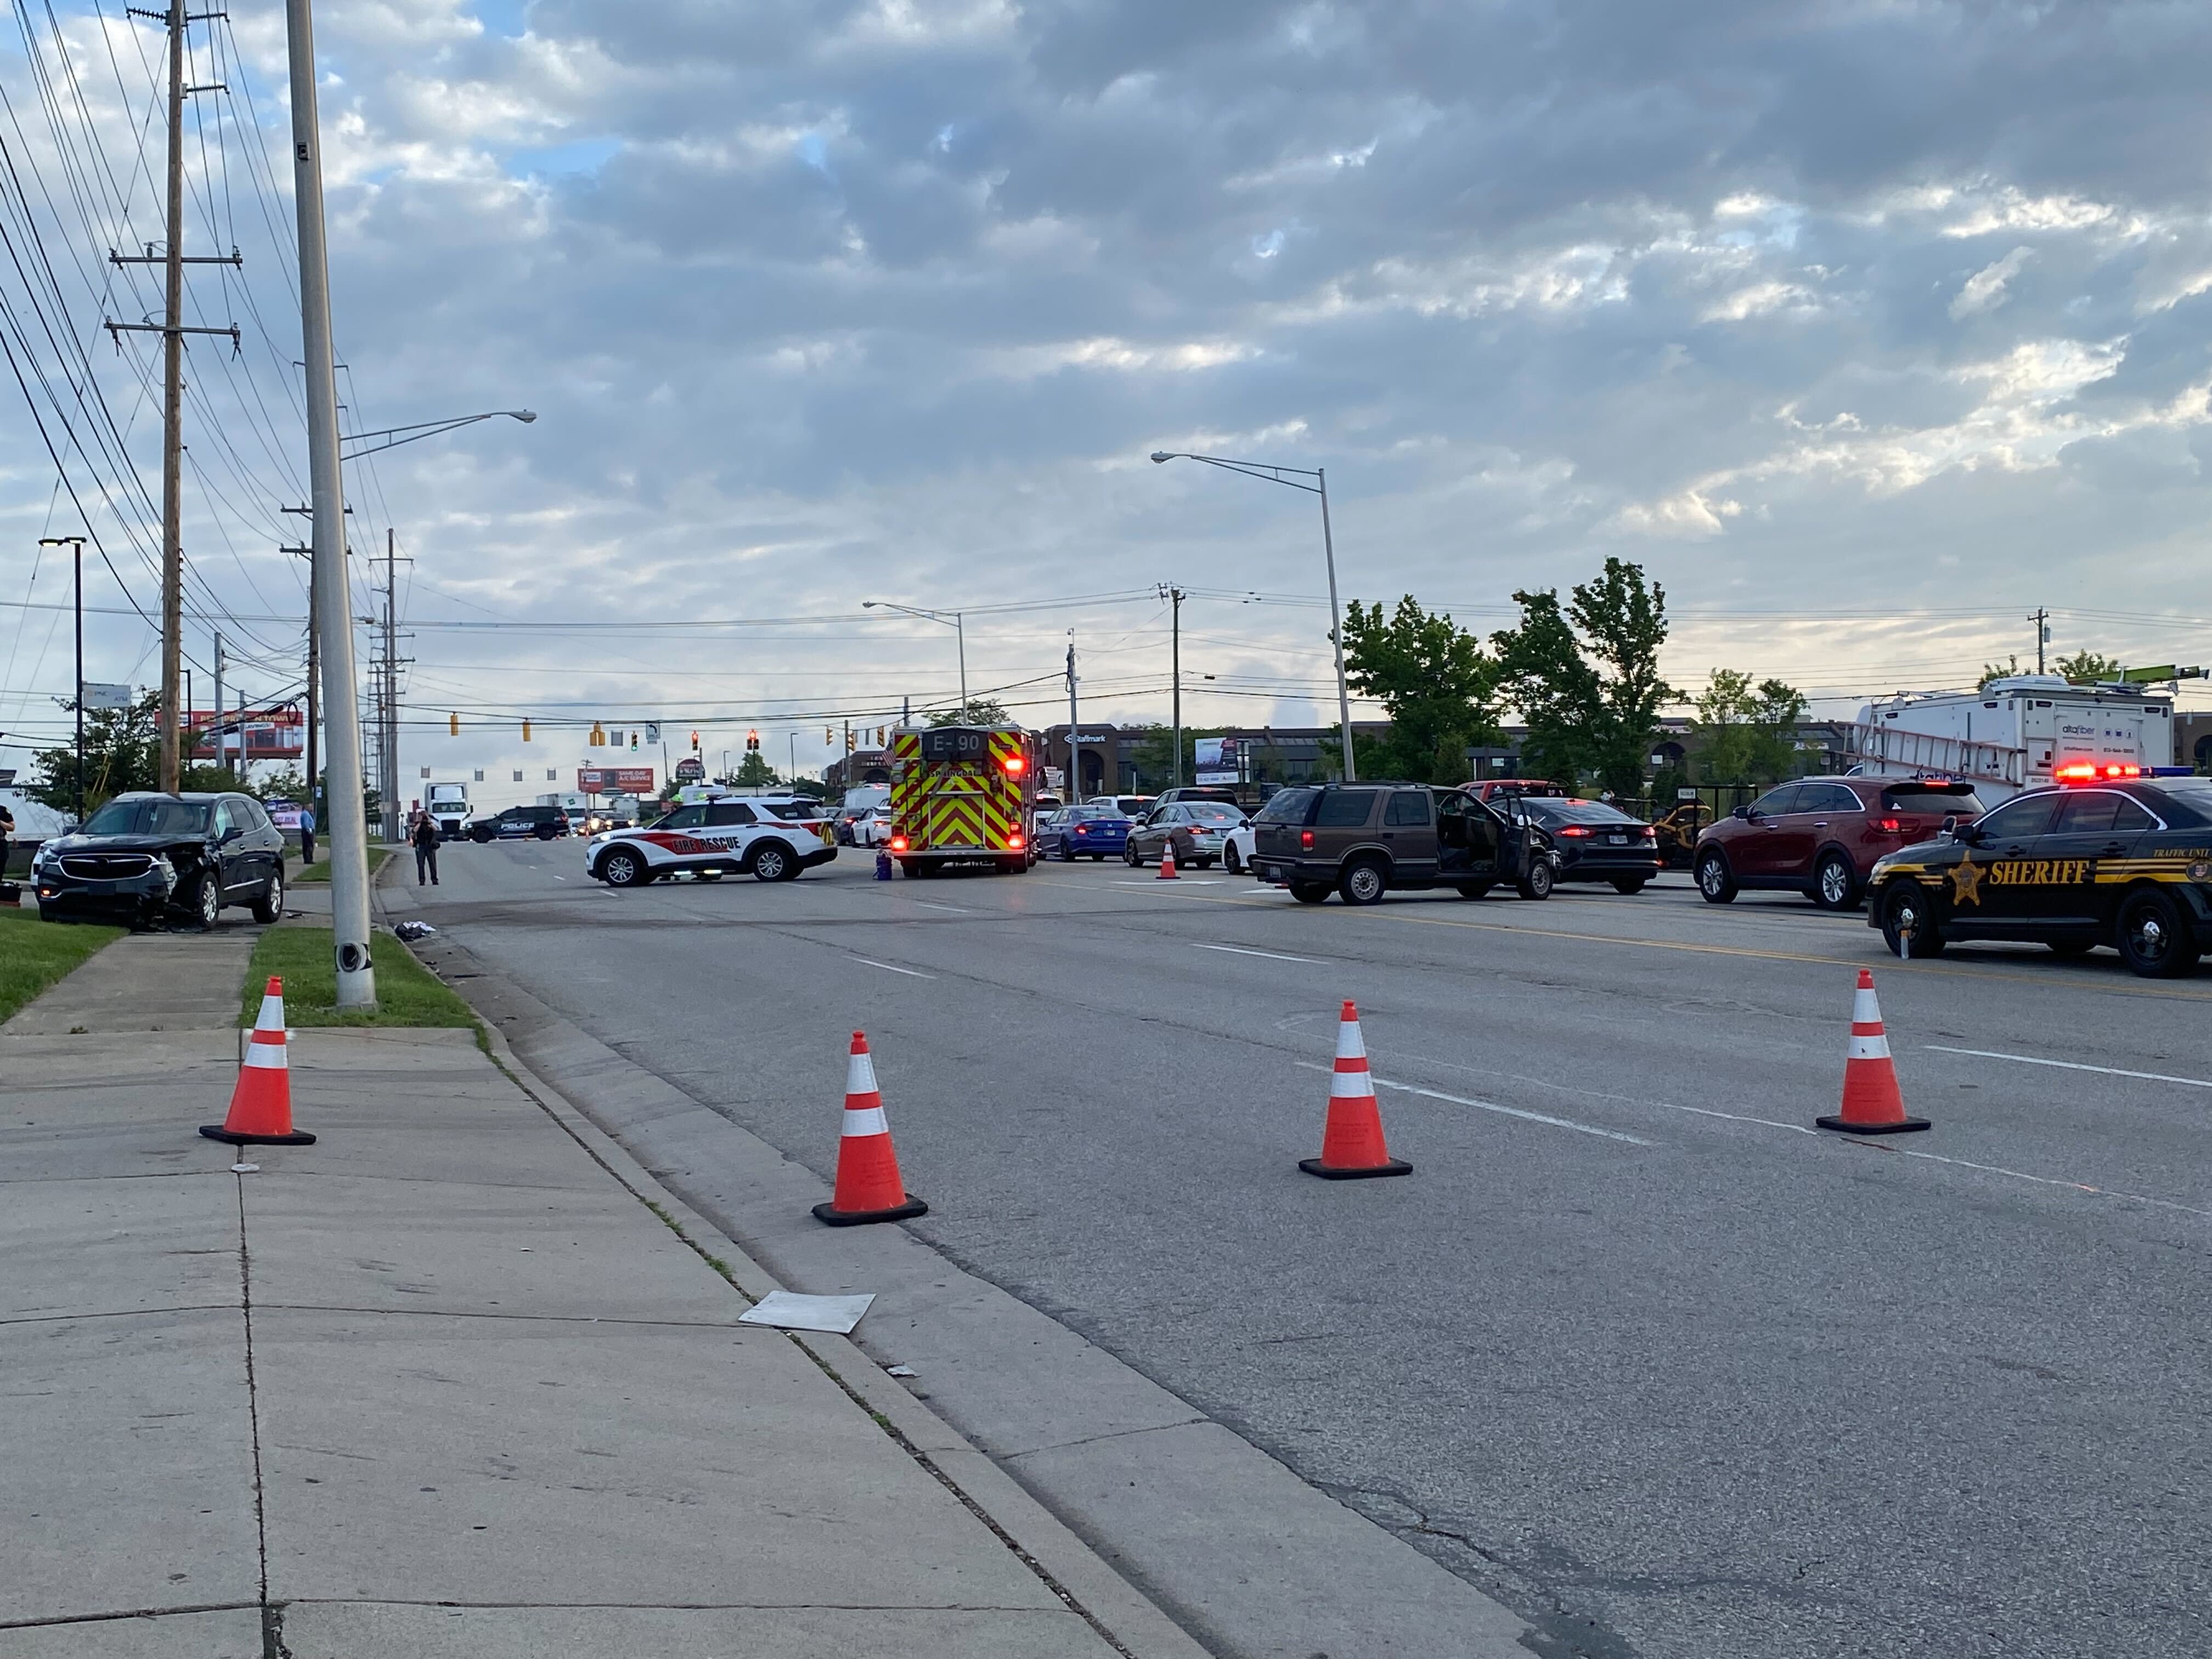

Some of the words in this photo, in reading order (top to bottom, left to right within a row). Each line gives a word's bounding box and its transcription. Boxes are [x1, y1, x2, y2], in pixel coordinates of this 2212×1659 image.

[672, 838, 697, 851] FIRE
[699, 836, 741, 851] RESCUE
[2153, 849, 2187, 857] TRAFFIC
[2188, 848, 2209, 857] UNIT
[1989, 860, 2090, 884] SHERIFF
